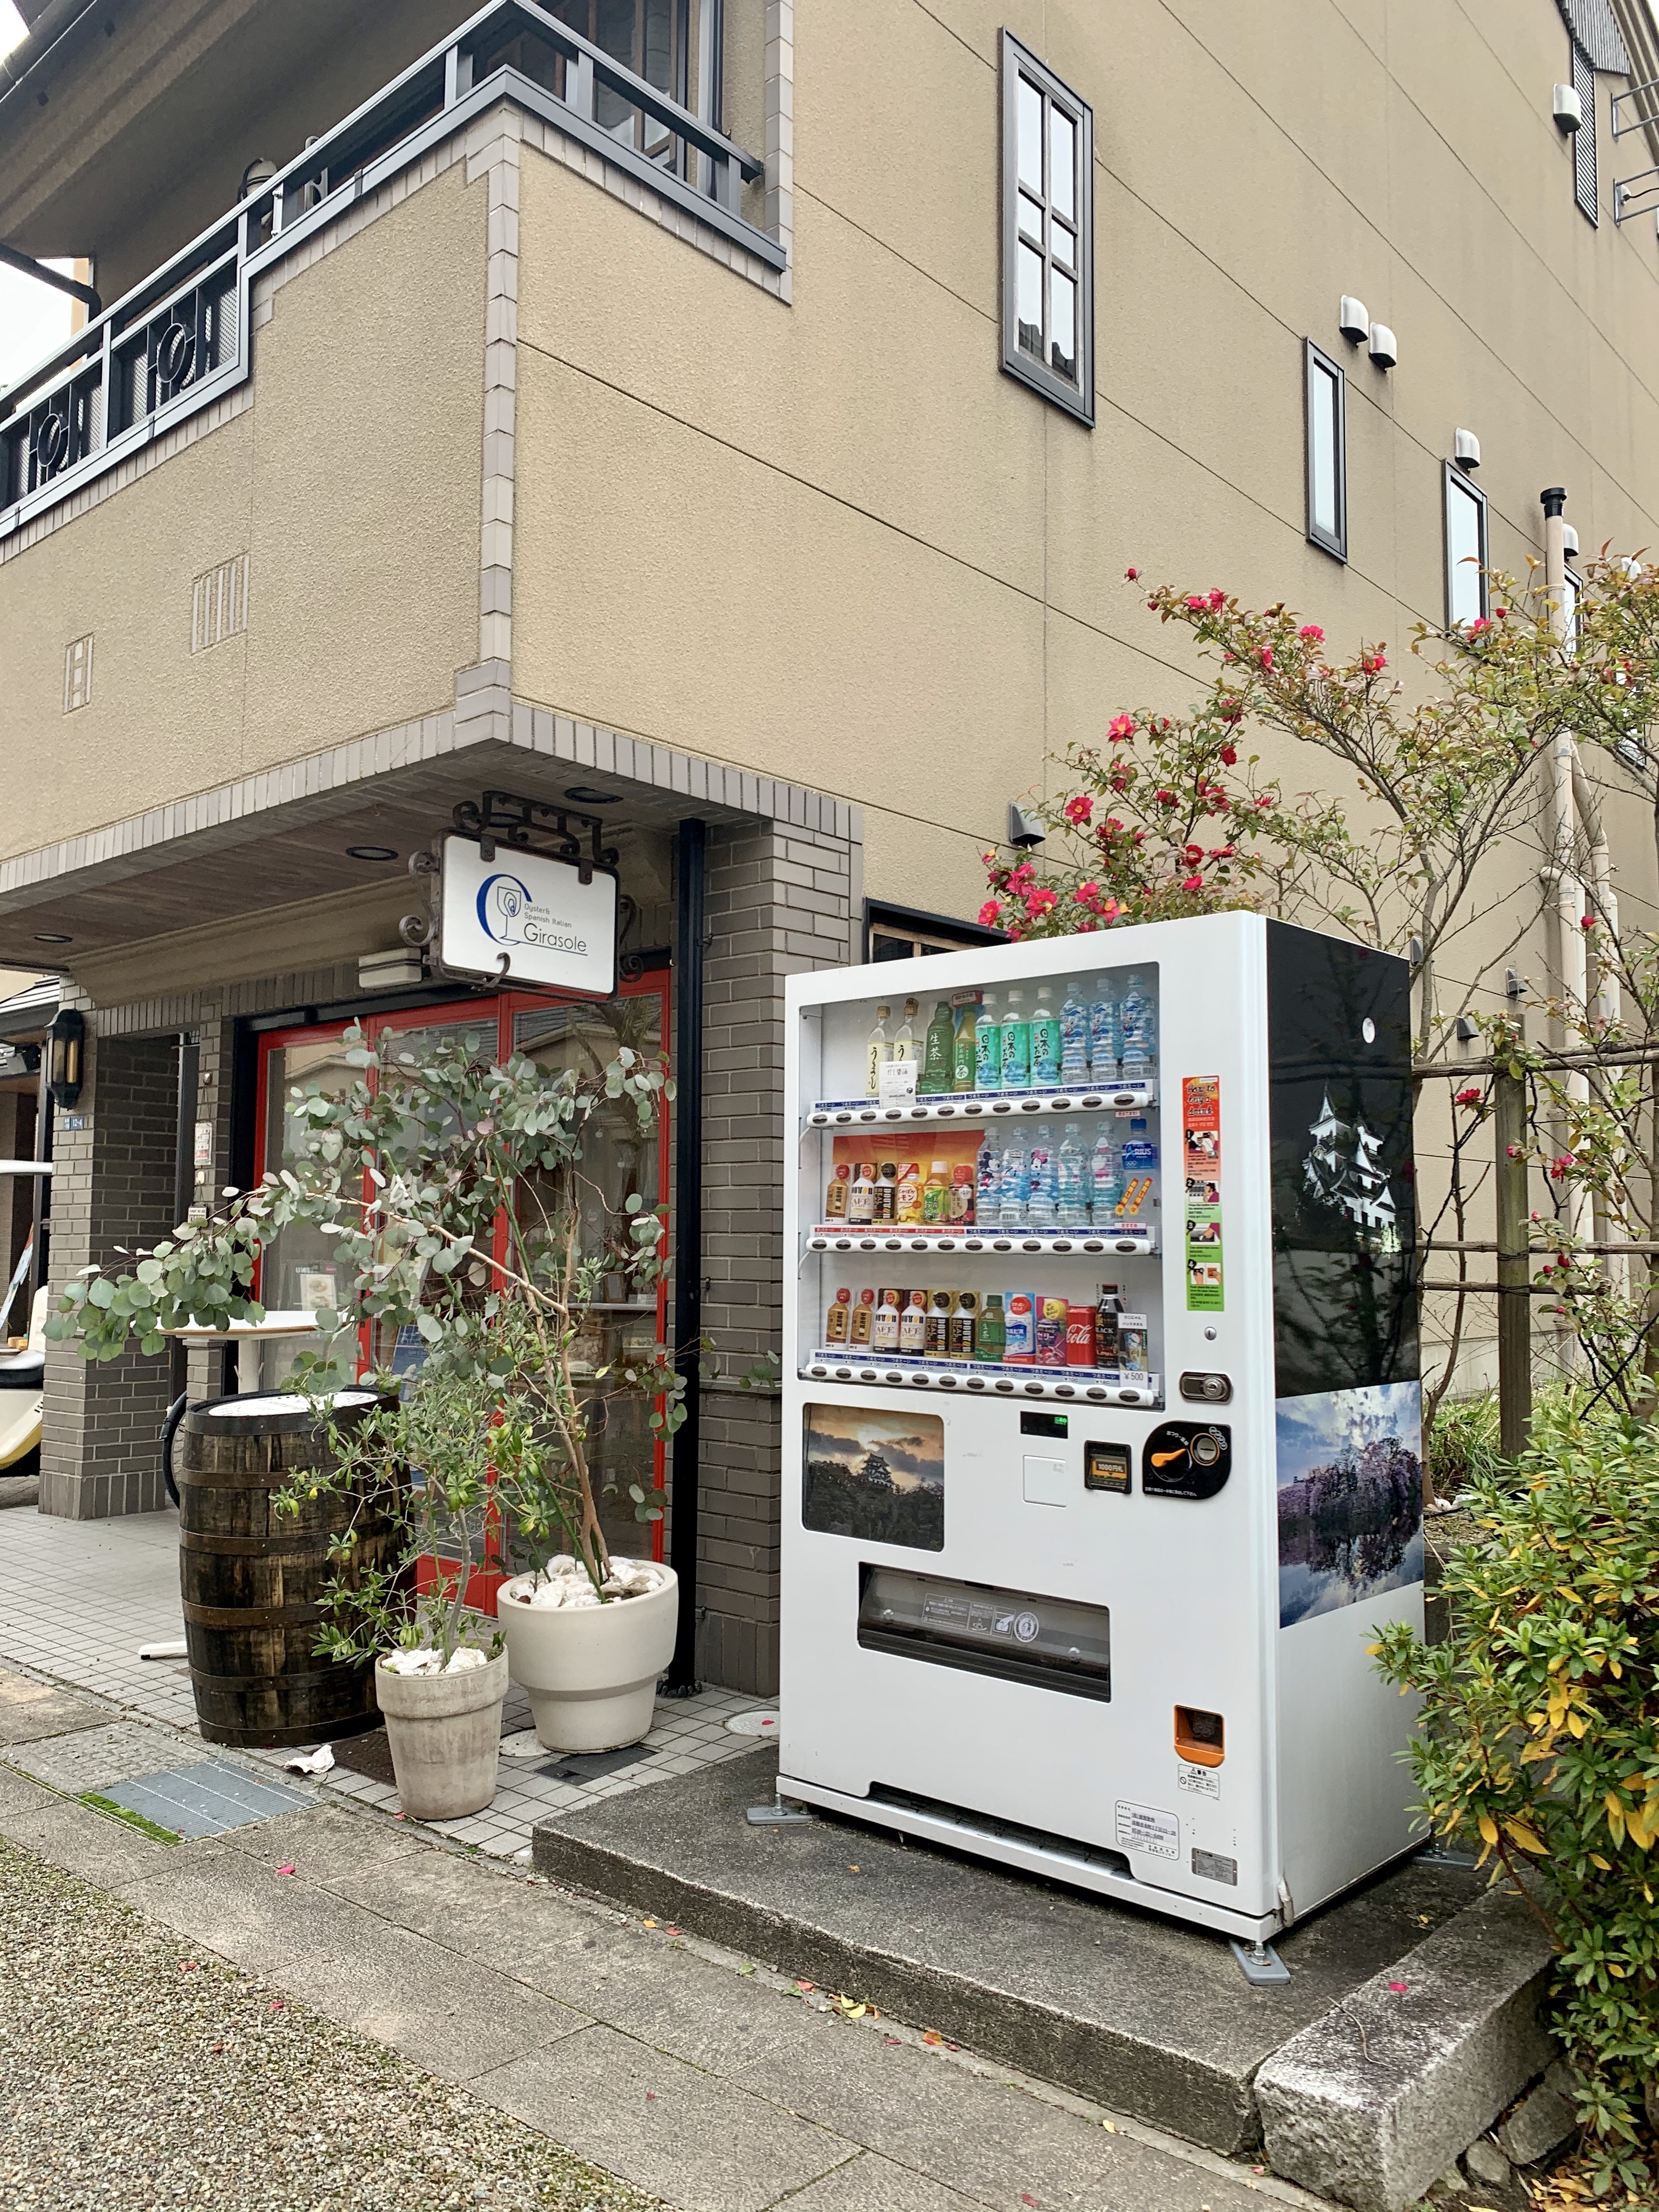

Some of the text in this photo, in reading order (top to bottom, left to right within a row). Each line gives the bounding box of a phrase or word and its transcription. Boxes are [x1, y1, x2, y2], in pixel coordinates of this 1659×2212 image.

[524, 903, 550, 915] Oyster&
[524, 912, 572, 928] Spanish Italian
[524, 923, 586, 952] Girasole
[929, 1033, 942, 1060] 生茶
[1066, 1324, 1093, 1344] Cola
[1124, 1373, 1143, 1381] ¥500
